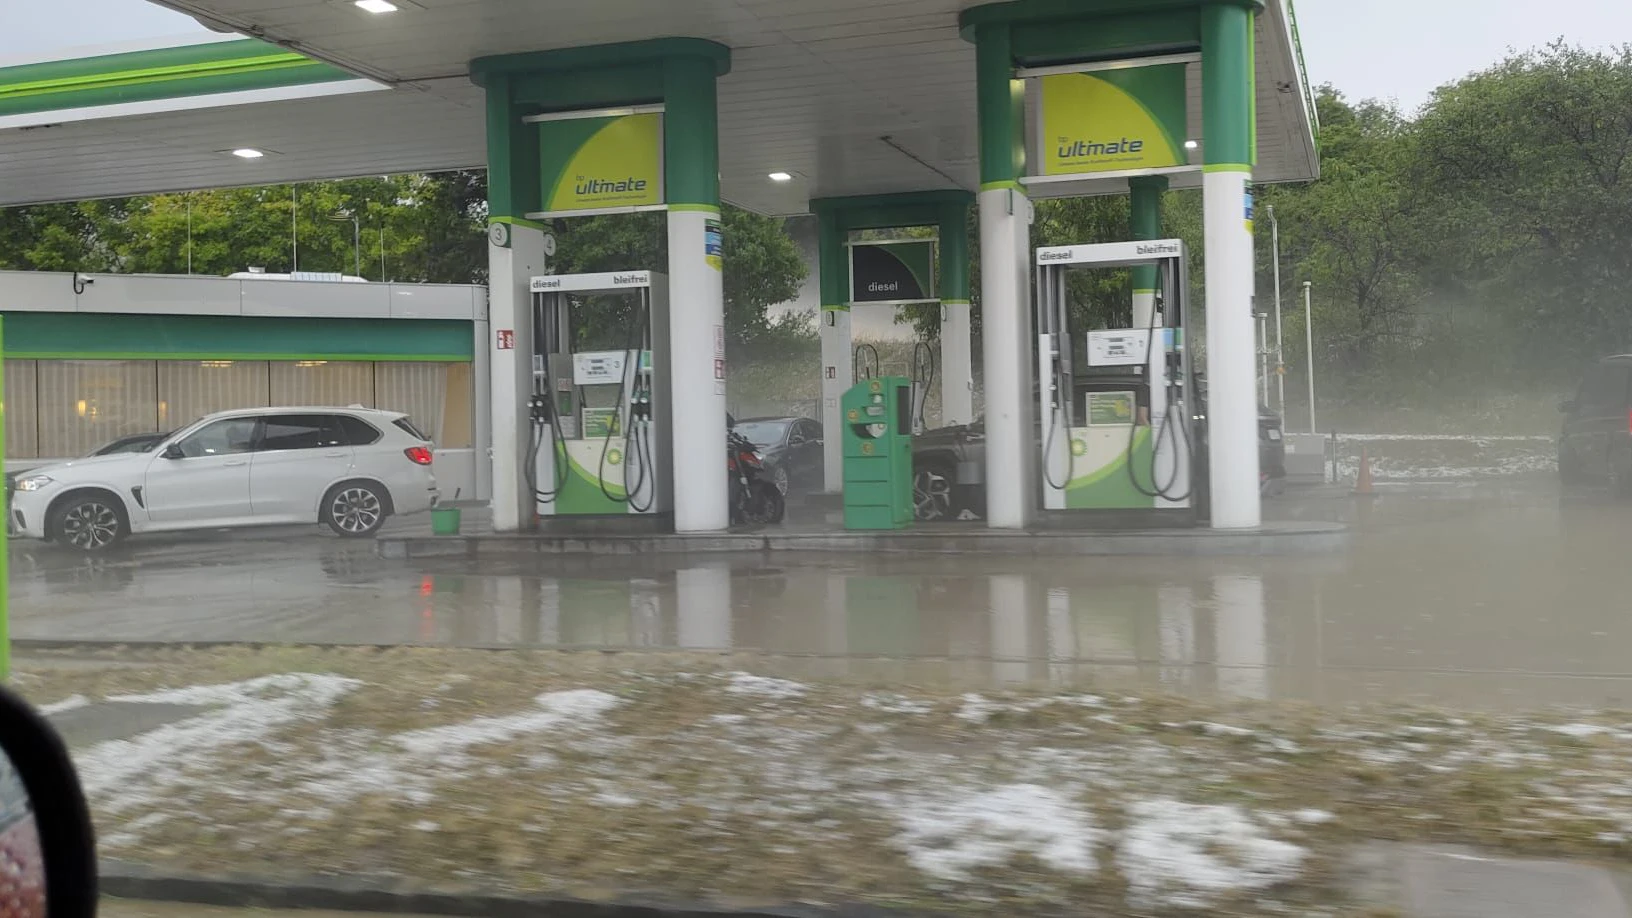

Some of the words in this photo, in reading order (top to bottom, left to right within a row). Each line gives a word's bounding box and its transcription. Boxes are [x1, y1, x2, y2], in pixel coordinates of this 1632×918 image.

[1058, 137, 1143, 158] ultimate
[576, 177, 646, 195] ultimate
[495, 228, 502, 240] 3
[1039, 250, 1072, 261] diesel
[1136, 244, 1178, 256] bleifrei
[532, 278, 561, 289] diesel
[613, 274, 648, 285] bleifrei
[868, 281, 898, 292] diesel
